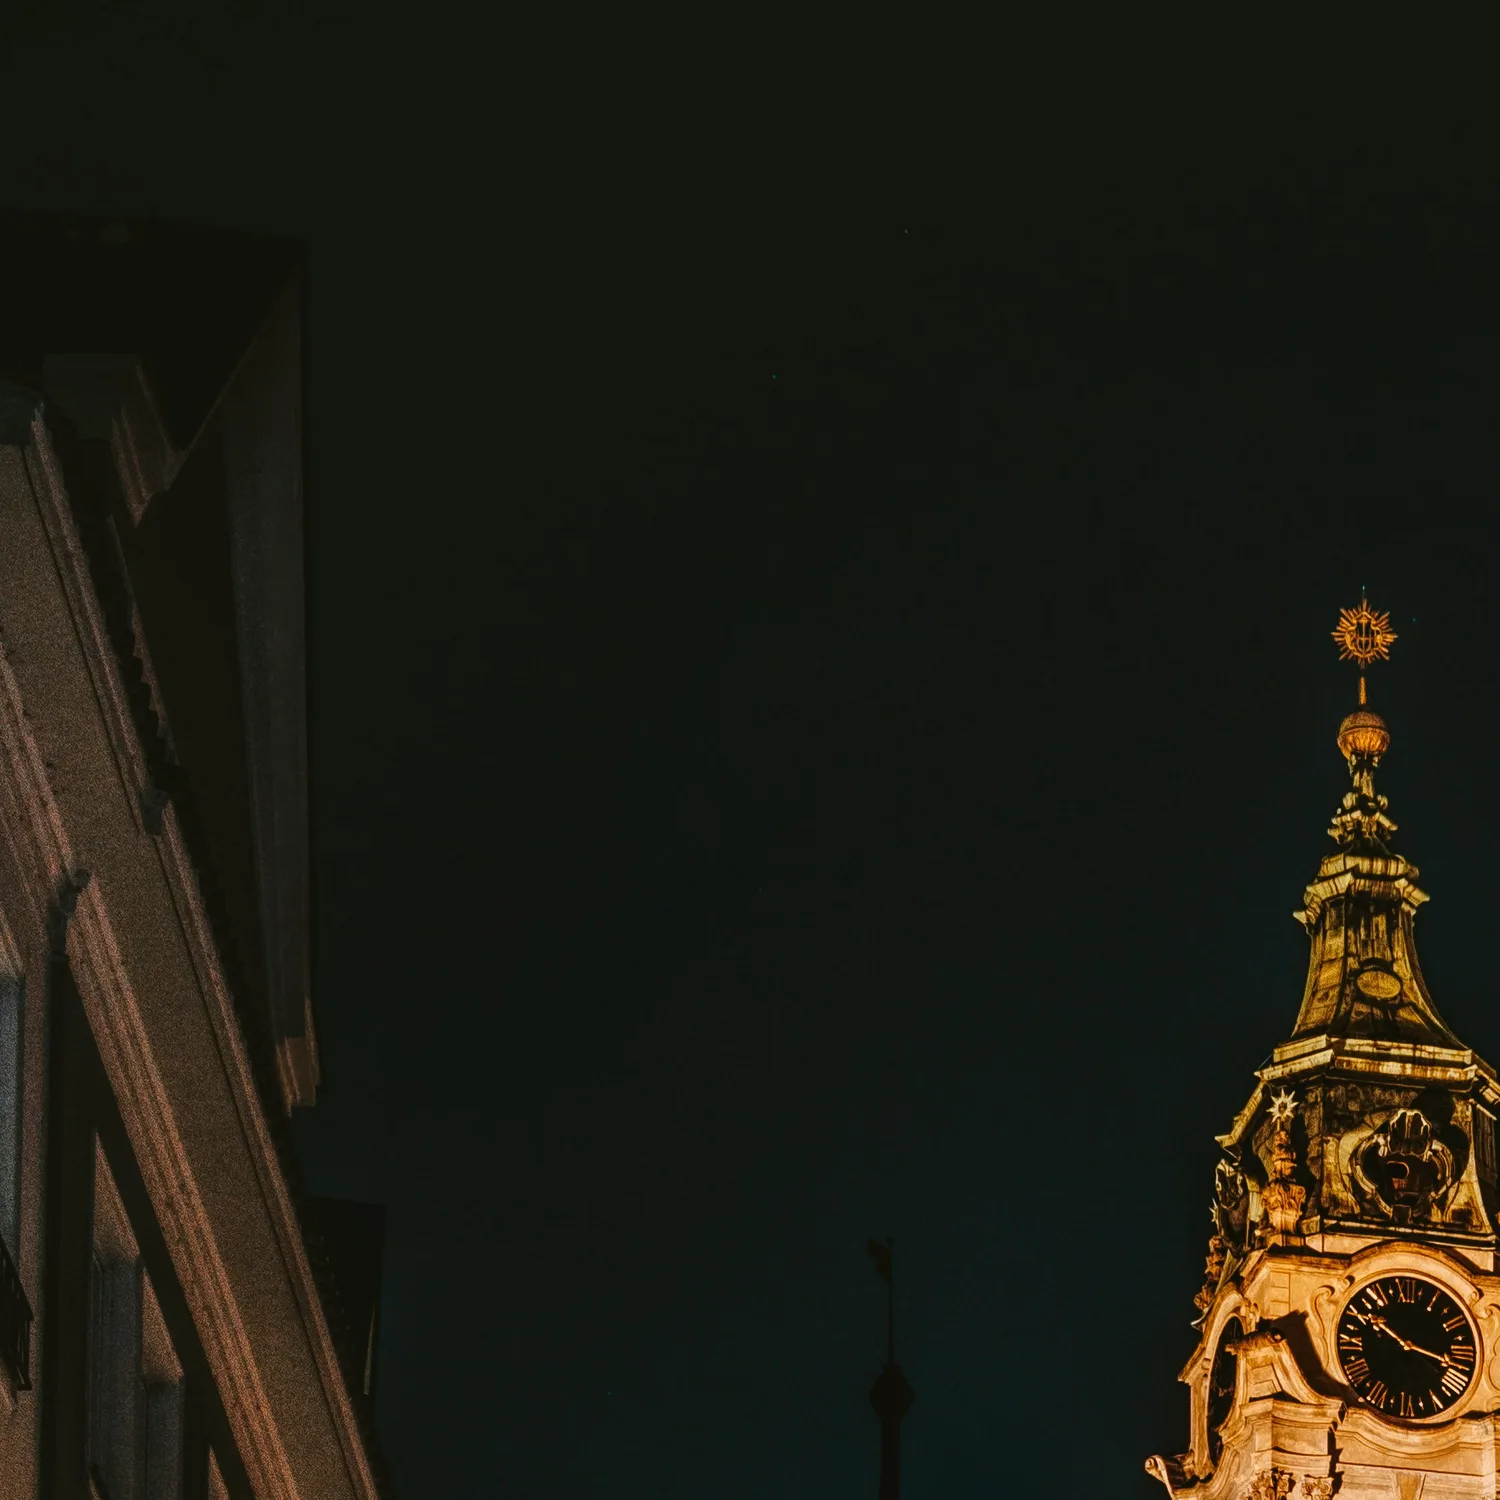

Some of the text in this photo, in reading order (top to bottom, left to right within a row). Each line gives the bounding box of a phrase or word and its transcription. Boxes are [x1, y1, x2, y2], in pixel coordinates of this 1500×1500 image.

[1395, 1278, 1415, 1303] XII
[1346, 1304, 1369, 1326] X
[1443, 1314, 1466, 1332] II
[1339, 1333, 1363, 1351] IX
[1451, 1345, 1474, 1362] III
[1400, 1391, 1415, 1417] VI
